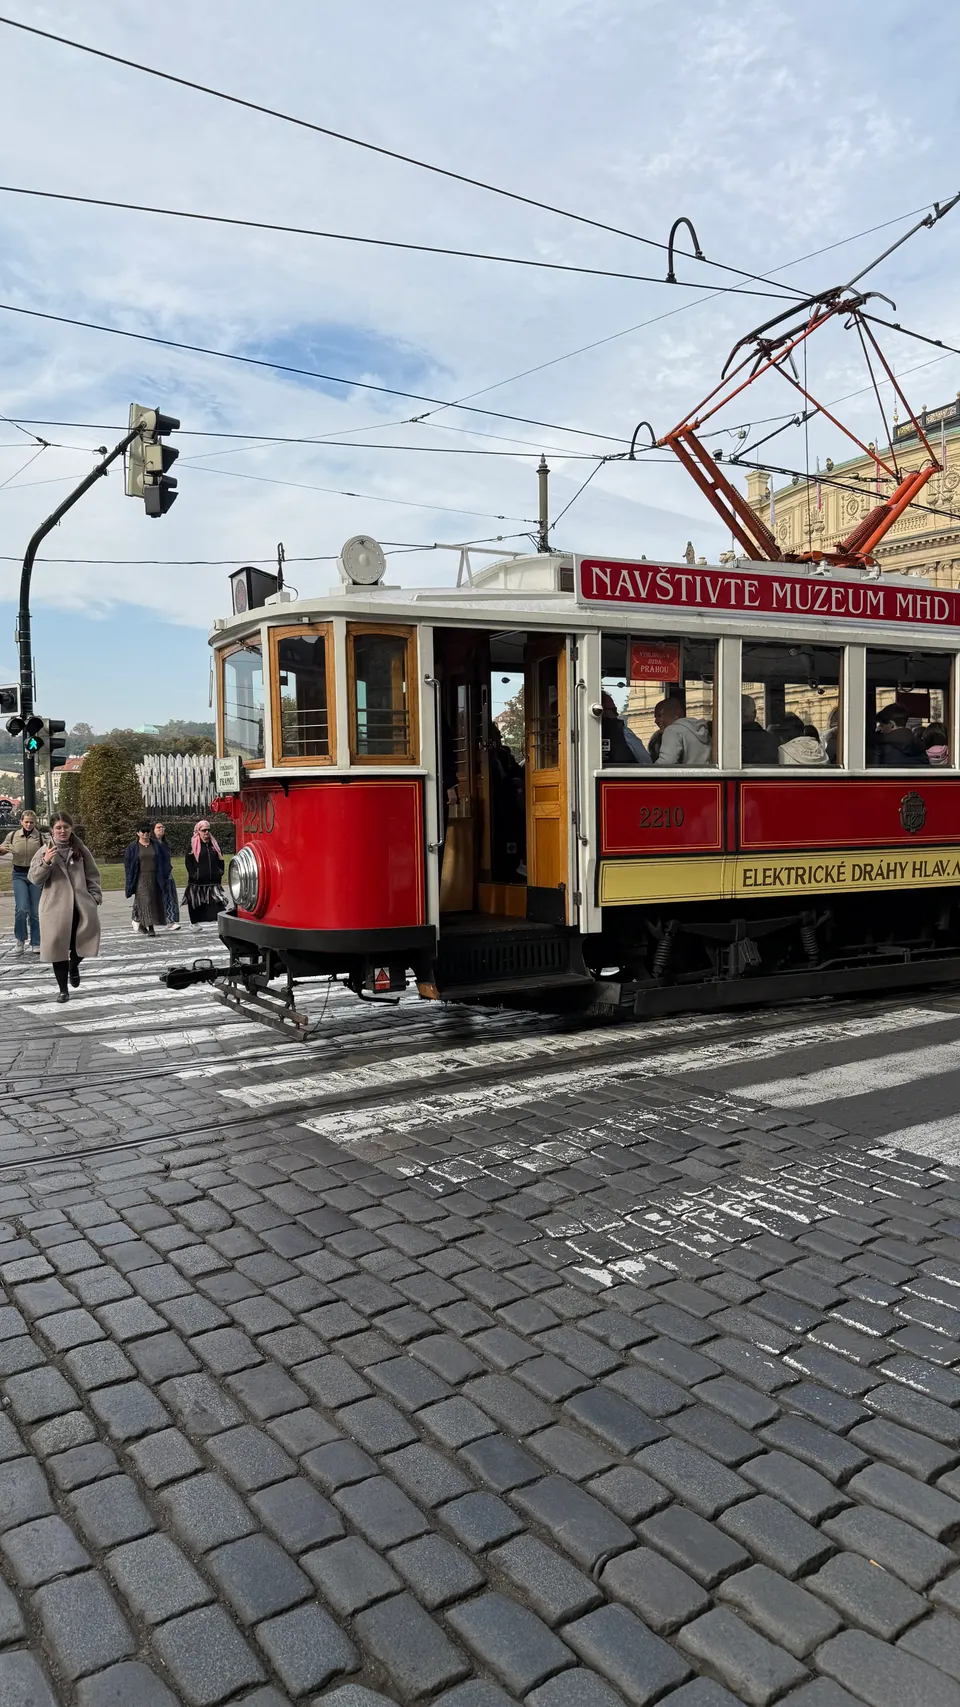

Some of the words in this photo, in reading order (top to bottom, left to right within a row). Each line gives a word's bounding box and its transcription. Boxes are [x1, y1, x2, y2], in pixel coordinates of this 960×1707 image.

[591, 567, 760, 606] NAVŠTIVTE
[772, 582, 885, 616] MUZEUM
[895, 593, 949, 620] MHD
[640, 665, 669, 674] PRAHOU
[639, 806, 684, 828] 2210
[742, 861, 847, 887] ELEKTRICKÉ
[851, 859, 909, 882] DRÁHY
